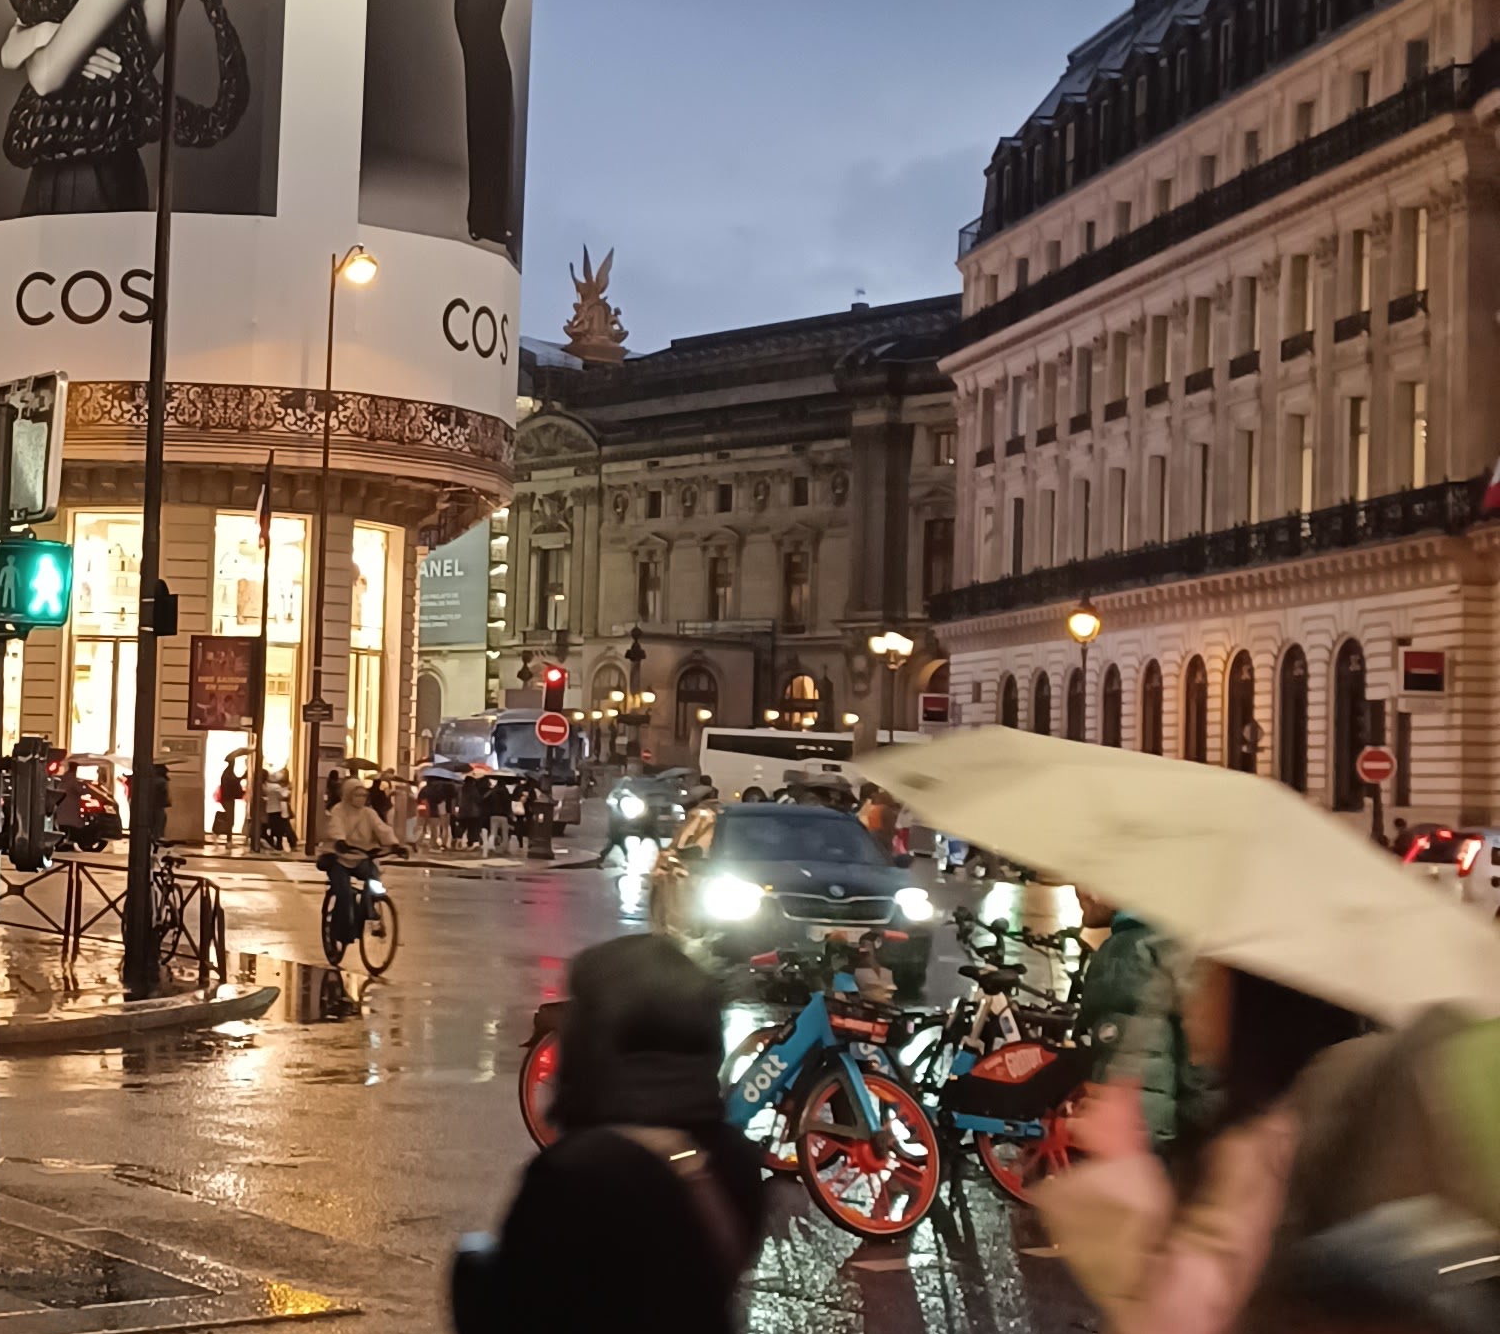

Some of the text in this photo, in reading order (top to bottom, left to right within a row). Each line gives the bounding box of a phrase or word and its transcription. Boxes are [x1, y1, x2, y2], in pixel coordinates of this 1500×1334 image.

[16, 268, 154, 326] COS
[442, 297, 509, 366] COS
[743, 1054, 789, 1103] dott
